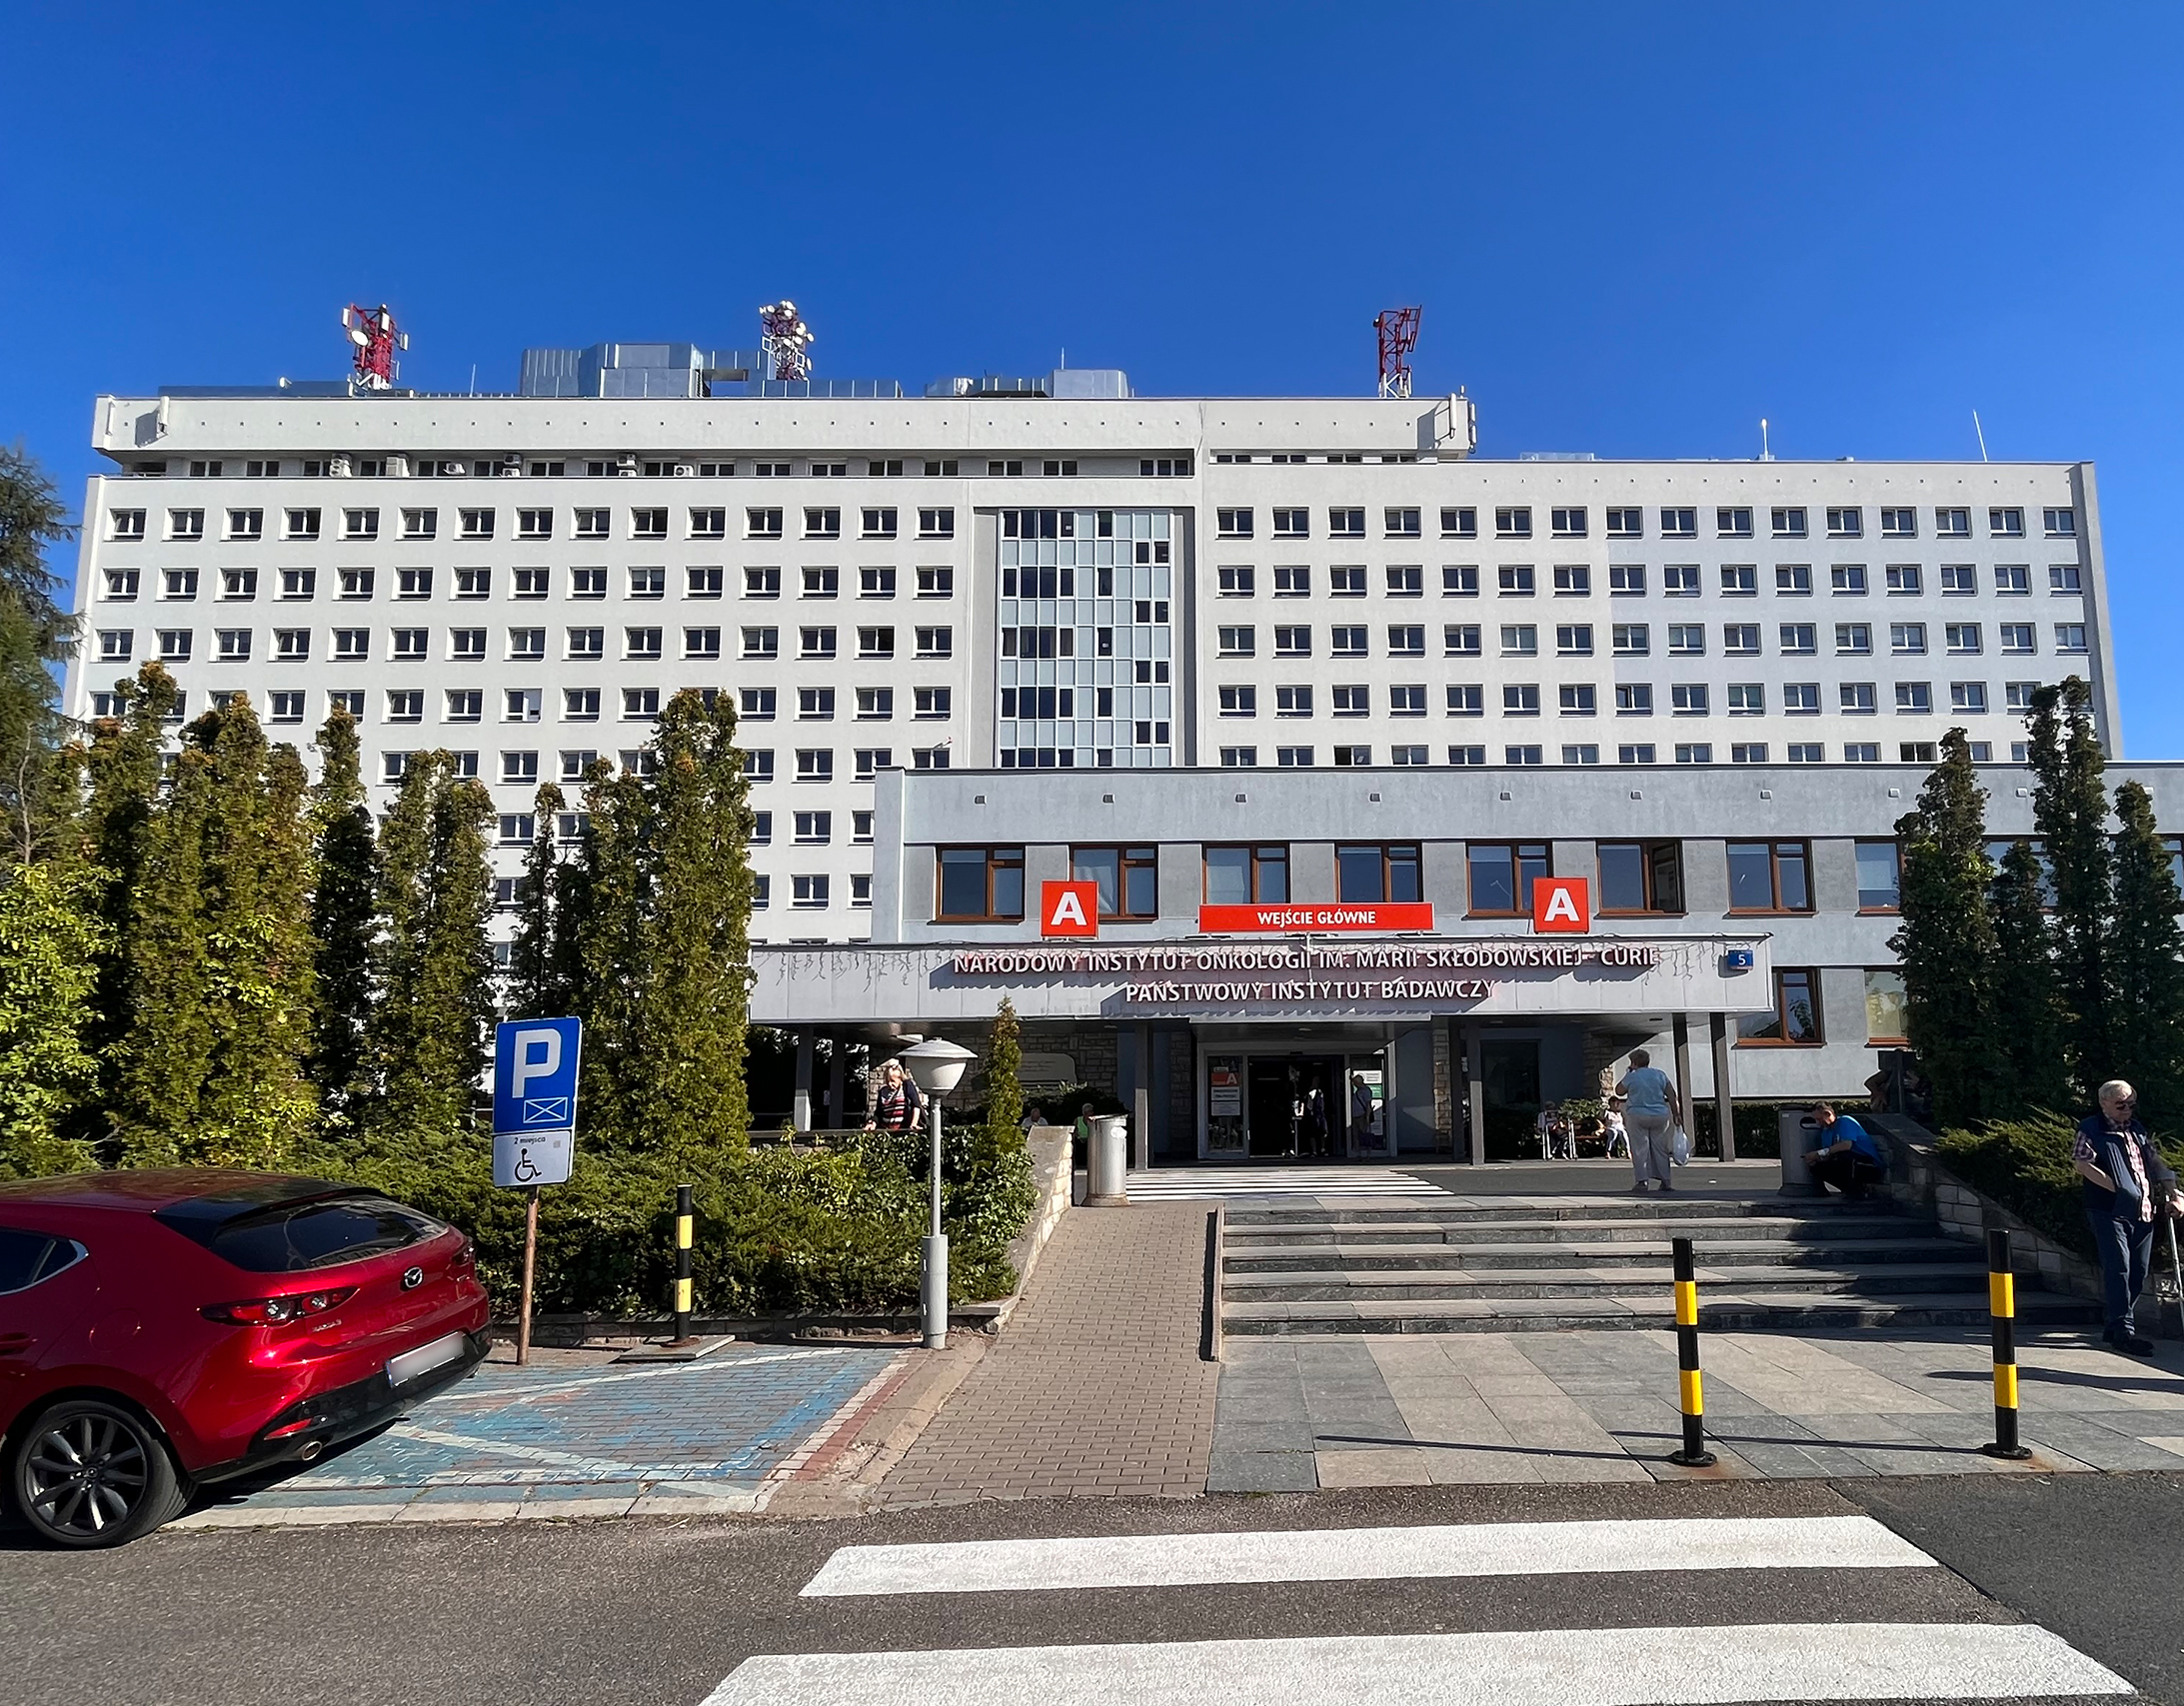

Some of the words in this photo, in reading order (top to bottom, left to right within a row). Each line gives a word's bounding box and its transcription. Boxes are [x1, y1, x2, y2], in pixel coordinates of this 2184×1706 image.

[1051, 891, 1088, 925] A
[1543, 886, 1581, 922] A
[1257, 908, 1313, 927] WEJŚCIE
[1317, 908, 1376, 924] GŁÓWNE
[955, 952, 1079, 973] NARODOWY
[1089, 951, 1189, 971] INSTYTUT
[1196, 951, 1310, 970] ONKOLOGII
[1319, 950, 1350, 968] IM.
[1356, 950, 1417, 968] MARII
[1600, 948, 1659, 967] CURIE
[1738, 954, 1746, 965] 5
[1126, 979, 1263, 1002] PAŃSTWOWY
[1271, 981, 1371, 1000] INSTYTUT
[1381, 980, 1496, 999] BADAWCZY
[512, 1028, 562, 1098] P
